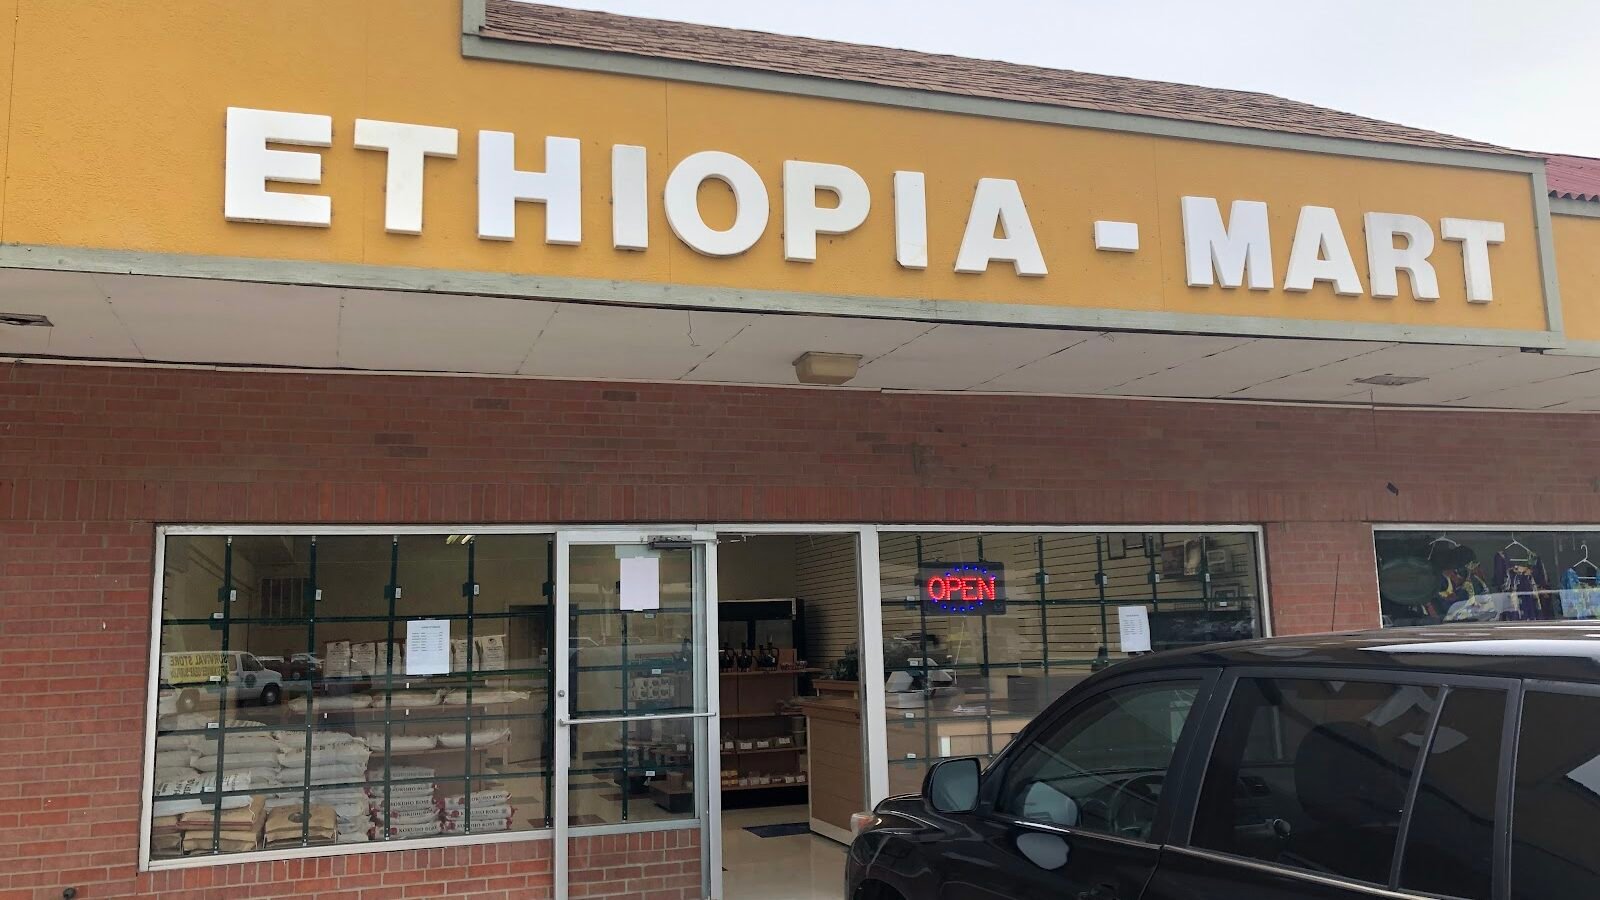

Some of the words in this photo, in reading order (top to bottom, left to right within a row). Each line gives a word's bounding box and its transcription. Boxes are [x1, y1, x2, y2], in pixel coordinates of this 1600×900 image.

[224, 106, 1048, 277] ETHIOPIA
[1181, 195, 1506, 304] MART
[927, 575, 996, 601] OPEN
